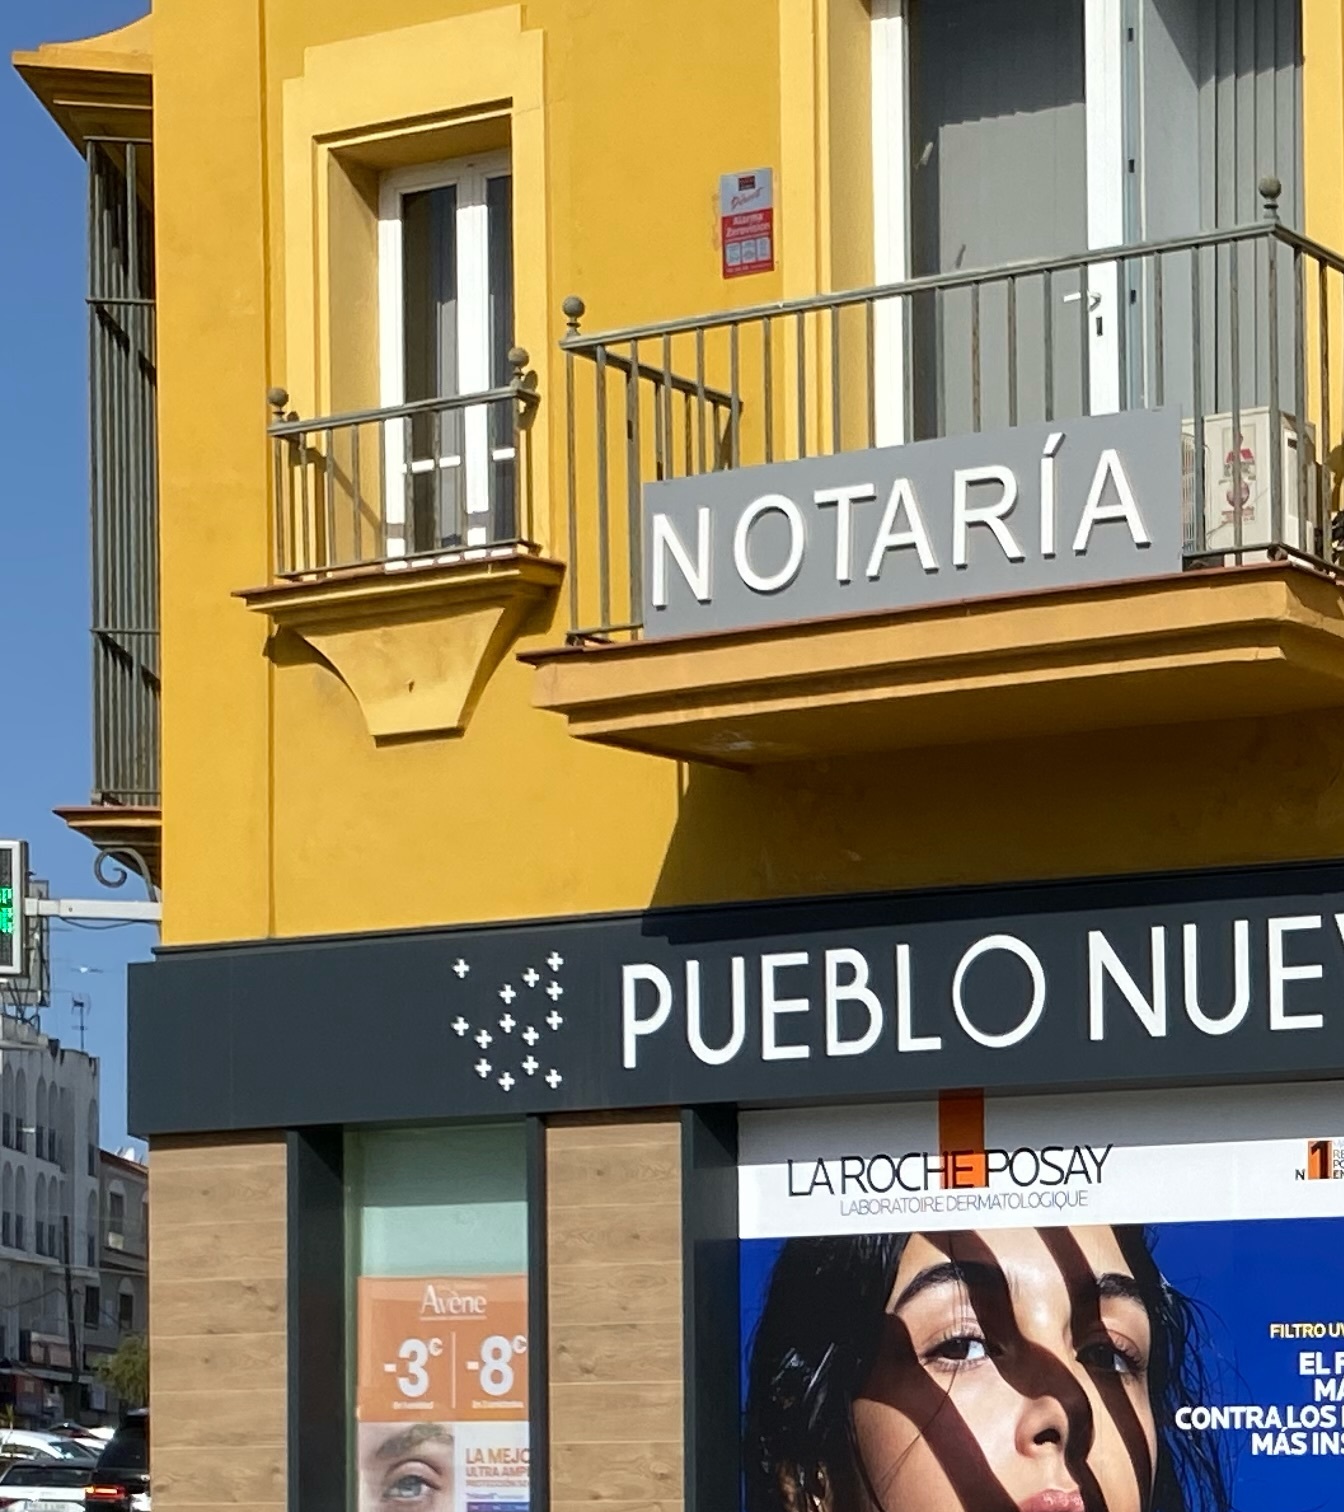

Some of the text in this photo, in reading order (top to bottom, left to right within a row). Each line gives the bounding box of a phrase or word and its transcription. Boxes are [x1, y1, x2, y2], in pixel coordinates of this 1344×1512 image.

[652, 432, 1150, 608] NOTARÍA
[622, 934, 1046, 1069] PUEBLO
[787, 1143, 1113, 1196] LA ROCHE POSAY
[1310, 1141, 1331, 1180] 1
[840, 1190, 1088, 1216] LABORATOIRE DERMATOLOGIQUE
[420, 1284, 487, 1314] Avène
[1270, 1323, 1326, 1338] FILTRO
[1299, 1352, 1330, 1375] EL
[1175, 1405, 1281, 1430] CONTRA
[1287, 1405, 1336, 1429] LOS
[1251, 1427, 1307, 1455] MÁS
[466, 1448, 484, 1465] LA
